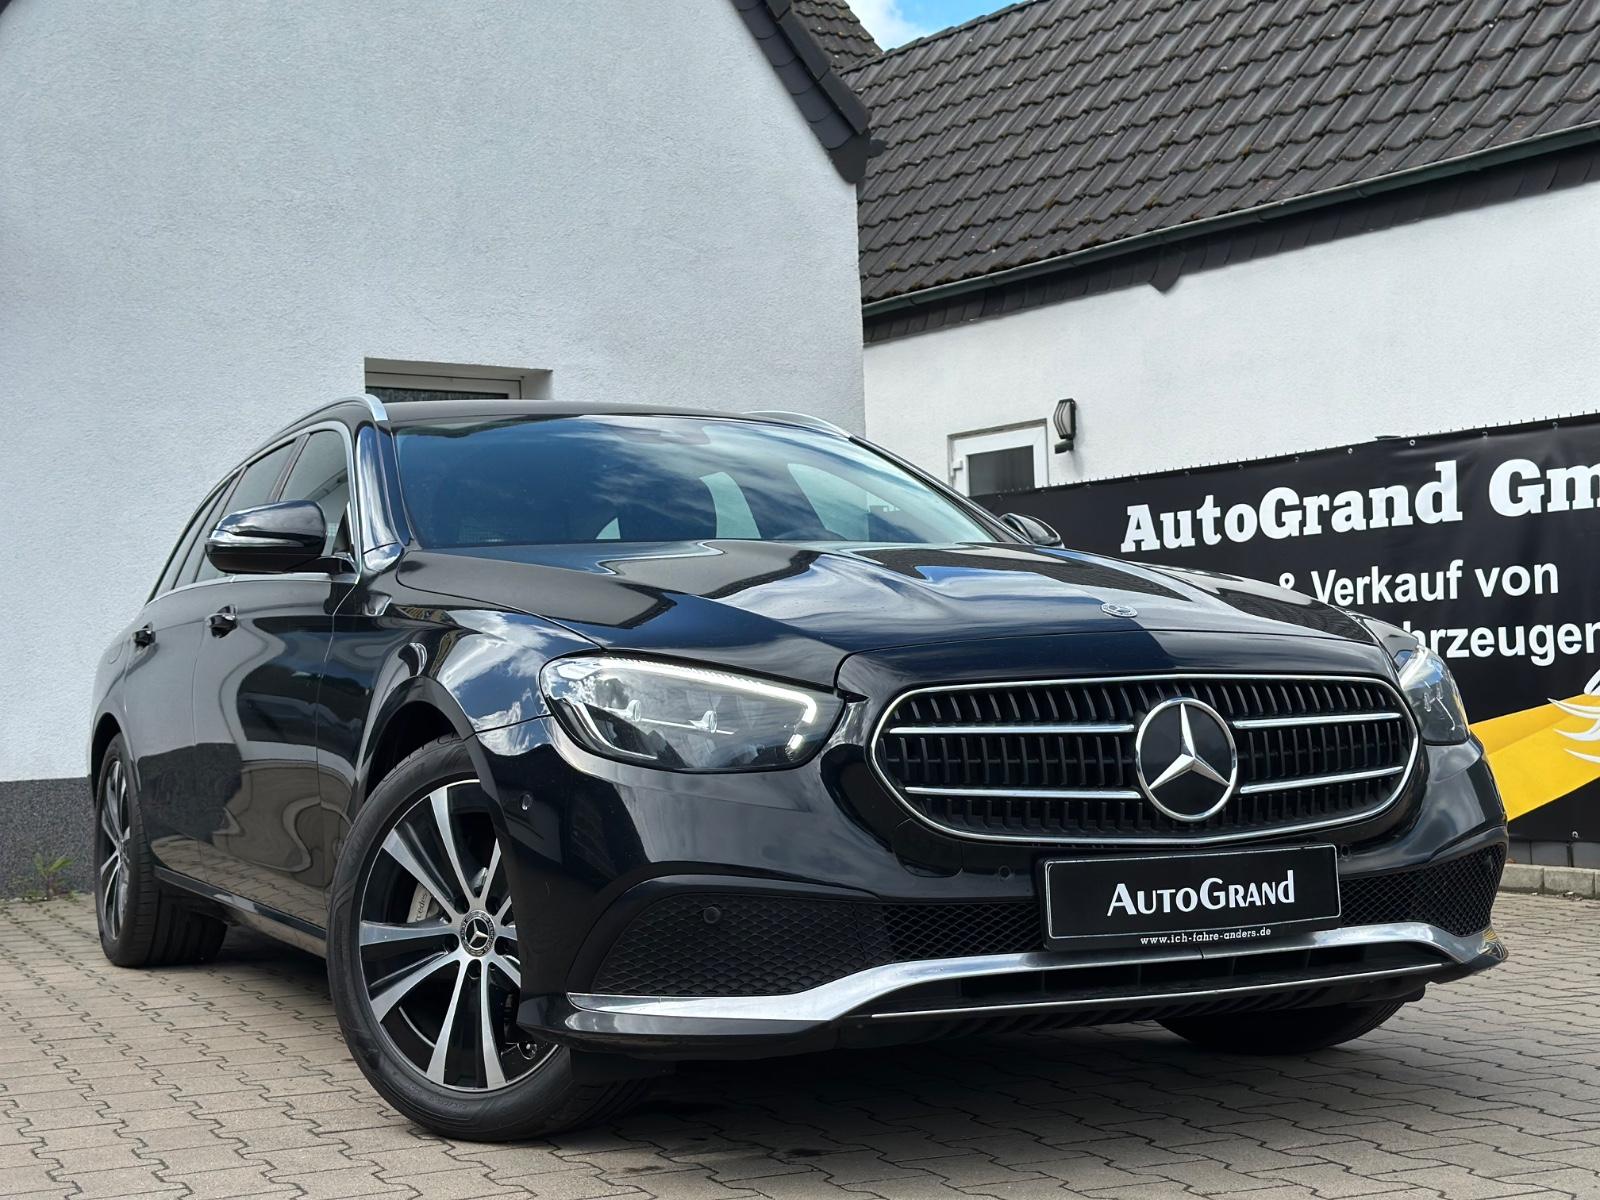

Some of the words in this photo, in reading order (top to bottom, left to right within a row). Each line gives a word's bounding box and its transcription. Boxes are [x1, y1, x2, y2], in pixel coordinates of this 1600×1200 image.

[1120, 460, 1463, 553] AutoGrand
[1311, 560, 1464, 607] Verkauf
[1474, 563, 1559, 598] von
[1140, 927, 1271, 945] www.ich-fahre-anders.de
